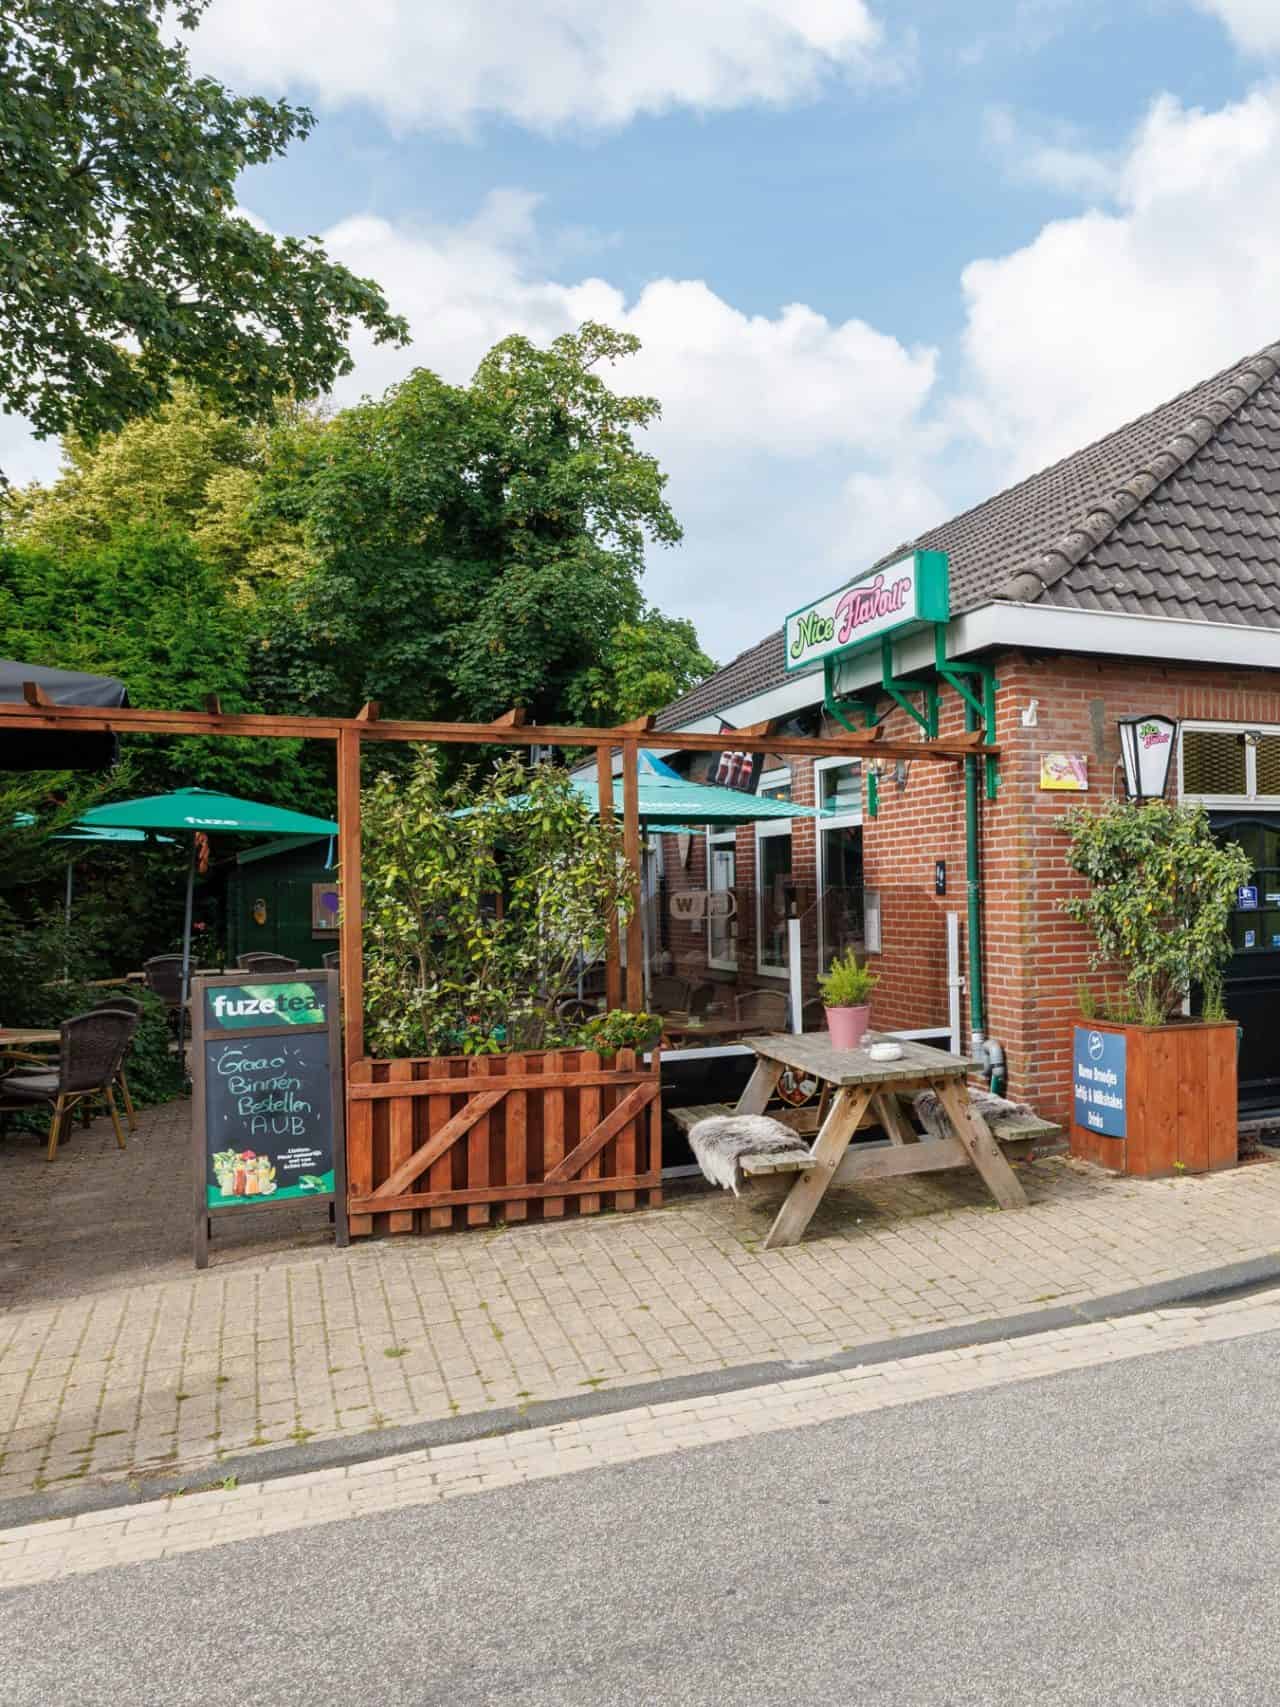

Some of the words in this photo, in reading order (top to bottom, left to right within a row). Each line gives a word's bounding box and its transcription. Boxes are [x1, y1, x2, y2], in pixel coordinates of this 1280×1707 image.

[790, 610, 835, 659] Nice
[834, 574, 912, 644] Flavour
[228, 1073, 301, 1095] Binnen
[238, 1091, 312, 1116] Bestellen
